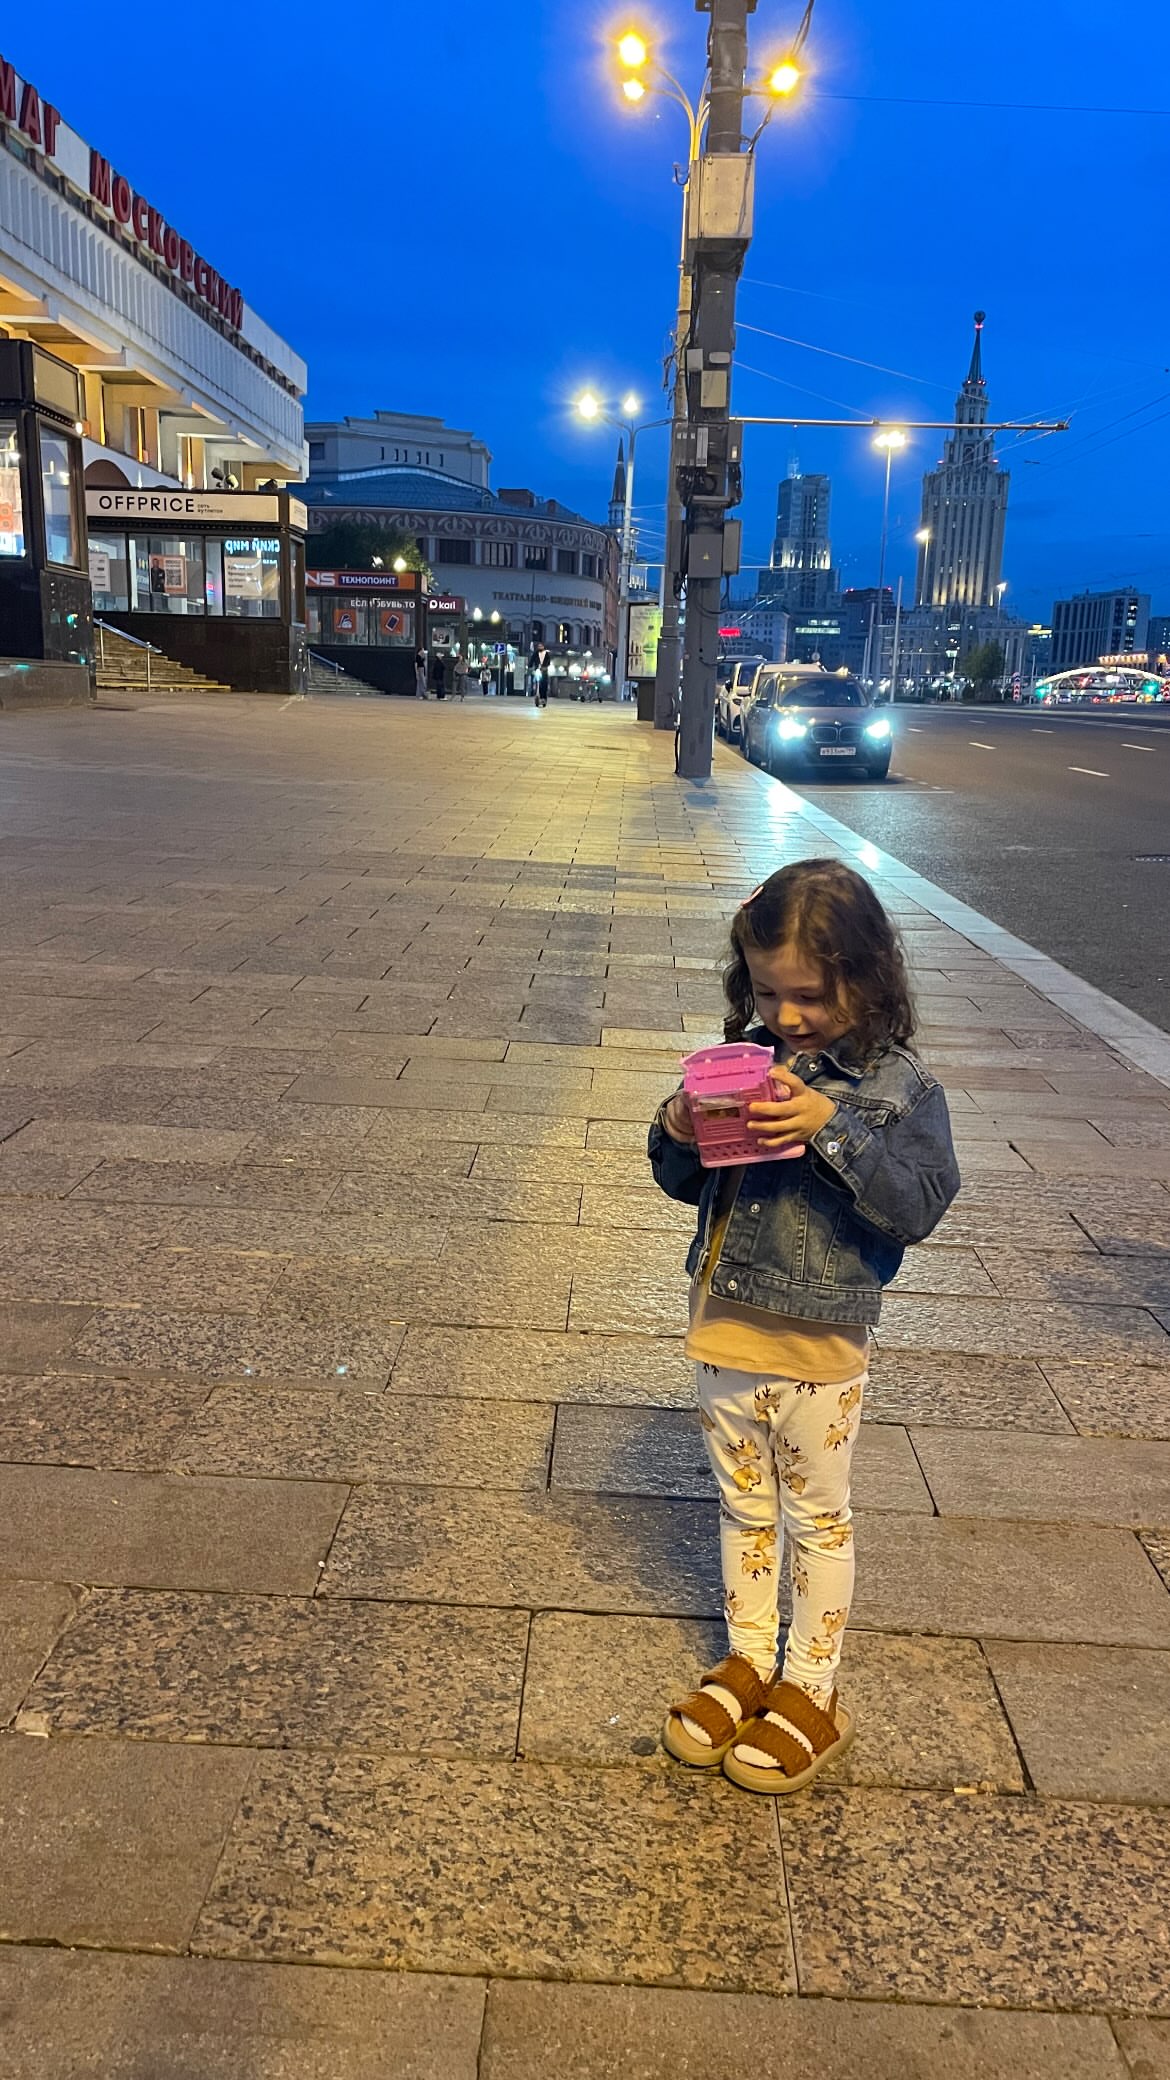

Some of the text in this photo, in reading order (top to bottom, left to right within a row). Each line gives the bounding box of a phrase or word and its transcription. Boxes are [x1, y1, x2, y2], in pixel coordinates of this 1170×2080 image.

[89, 147, 243, 331] МОСКОВСКИЙ
[99, 495, 195, 513] OFFPRICE
[340, 574, 397, 586] ТЕХНОПОИНТ
[438, 600, 456, 610] kari
